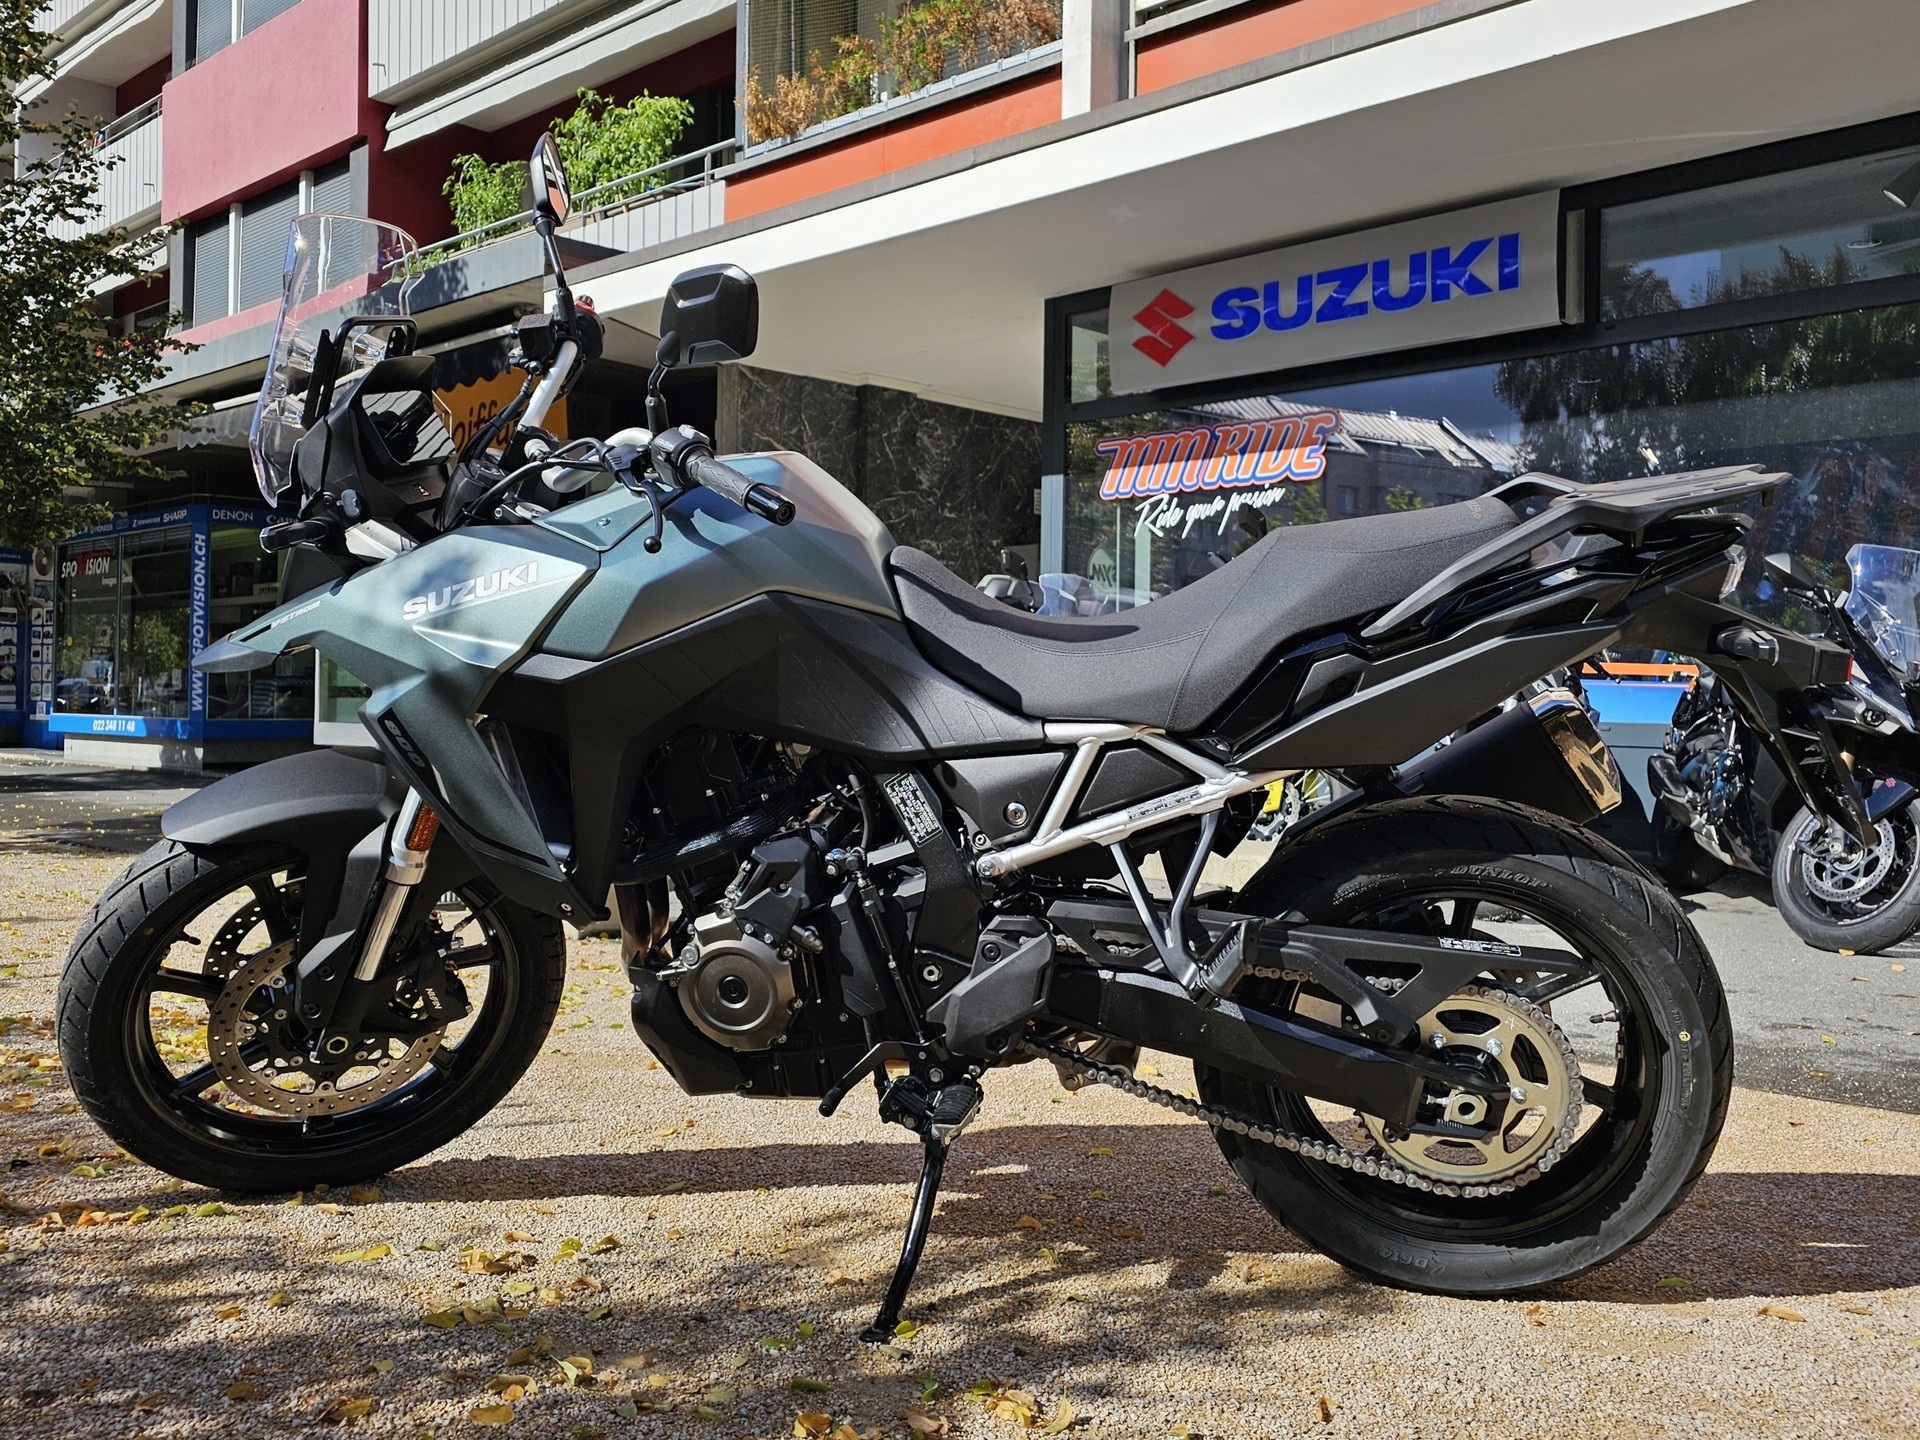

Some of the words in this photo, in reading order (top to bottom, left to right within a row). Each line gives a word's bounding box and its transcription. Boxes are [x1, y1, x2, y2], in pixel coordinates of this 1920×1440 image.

[1210, 232, 1521, 341] SUZUKI
[162, 509, 187, 523] SHARP
[212, 509, 254, 521] DENON
[1134, 493, 1184, 538] Ride
[402, 561, 538, 621] SUZUKI
[93, 719, 104, 731] 022
[118, 720, 125, 731] 11
[126, 720, 136, 732] 48
[383, 719, 426, 768] 800
[1450, 864, 1548, 888] DUNLOP
